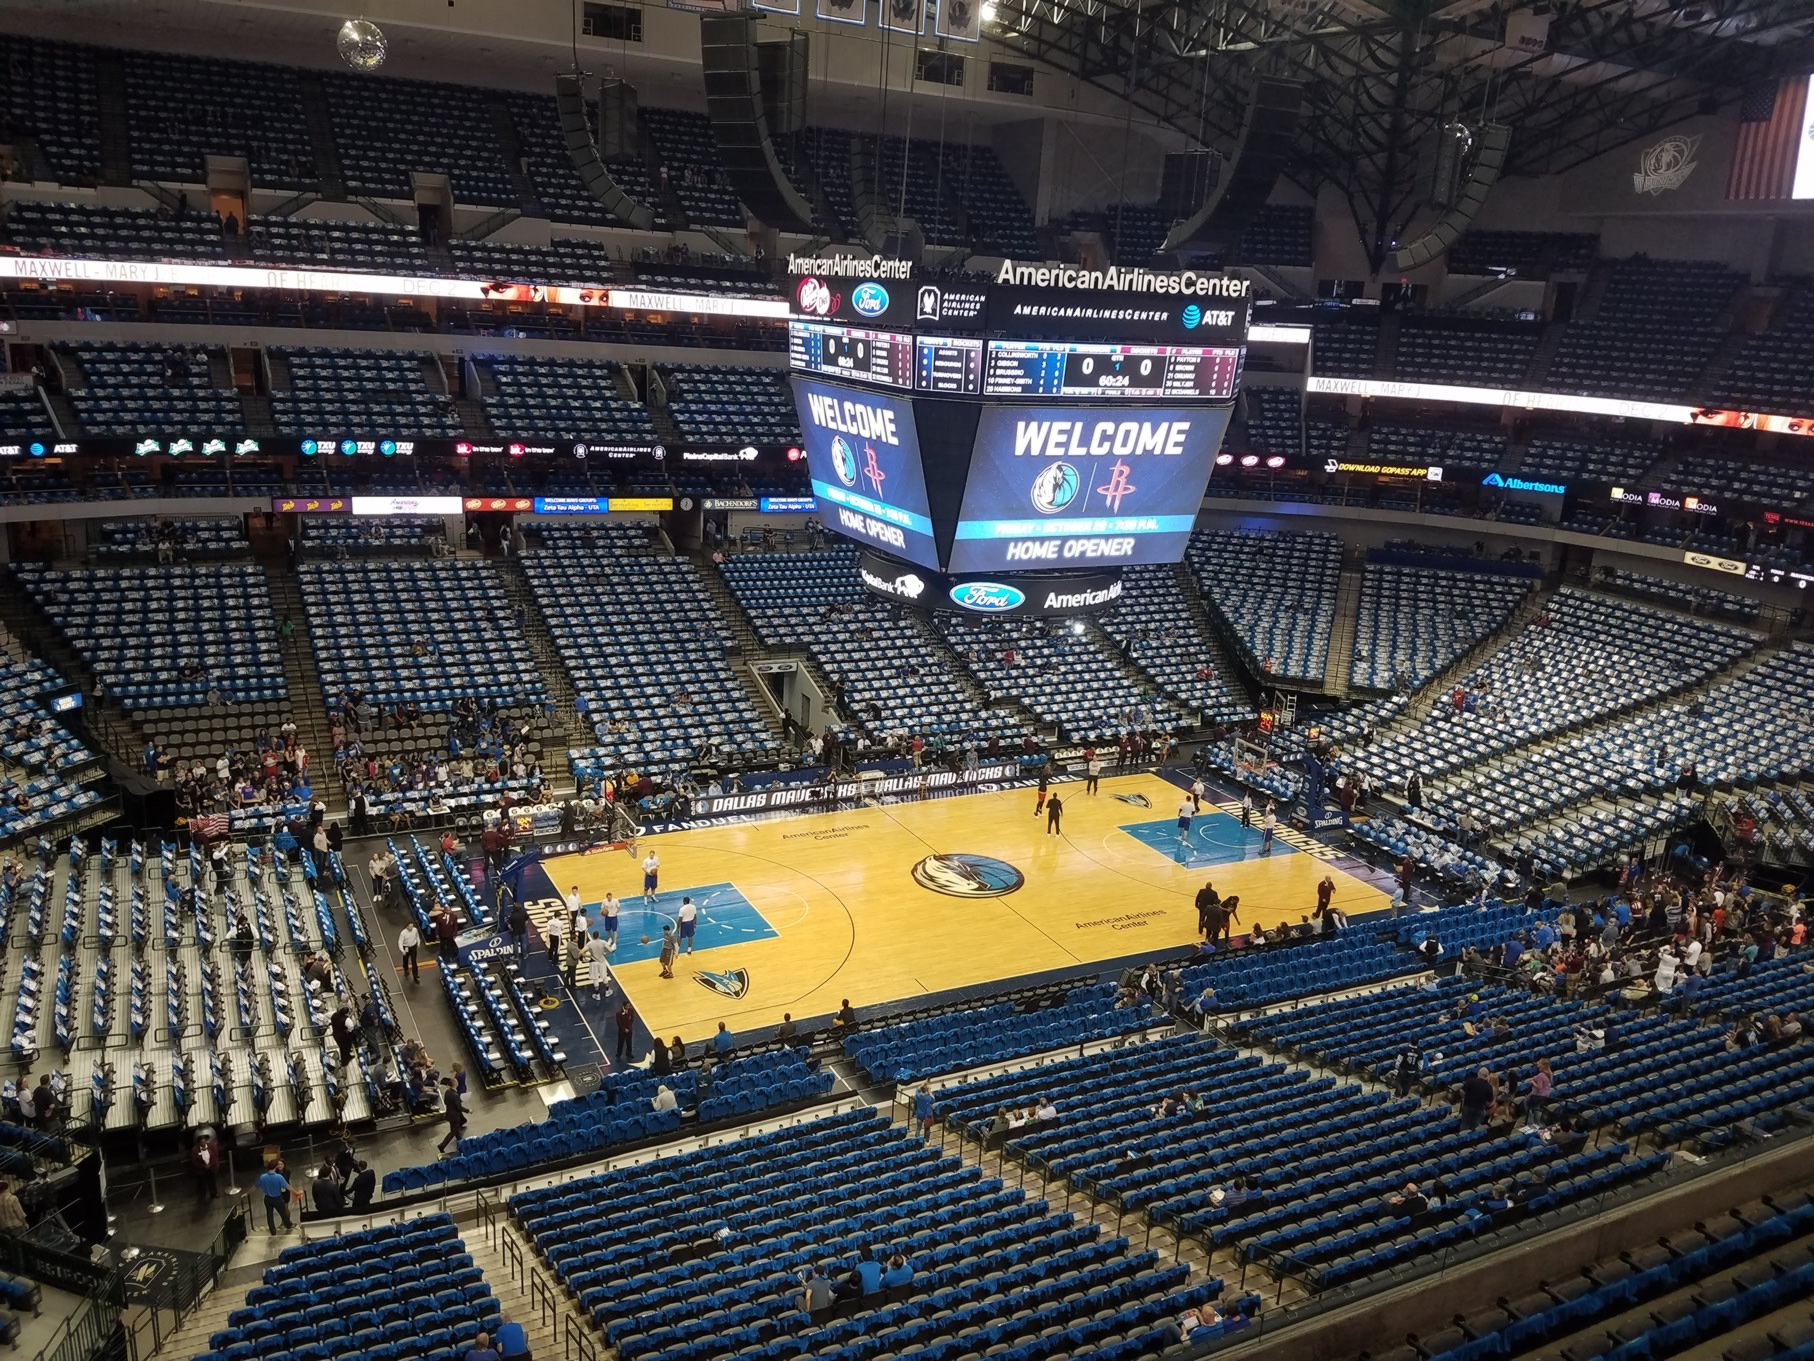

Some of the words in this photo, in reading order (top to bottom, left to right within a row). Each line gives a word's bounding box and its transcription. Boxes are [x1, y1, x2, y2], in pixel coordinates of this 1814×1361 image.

[14, 260, 91, 279] MAXWELL
[787, 252, 912, 279] AmericanAirlinesCenter
[997, 259, 1250, 298] AmericanAirlinesCenter
[629, 293, 684, 311] MAXWELL
[857, 287, 882, 311] Ford
[941, 300, 981, 310] AIRLINES
[942, 292, 986, 302] AMERICAN
[941, 308, 975, 318] CENTER
[1013, 303, 1168, 321] AMERICANAIRLINESCENTER
[1202, 310, 1236, 327] AT&T
[1082, 357, 1095, 375] 0
[1140, 359, 1153, 376] 0
[1114, 362, 1120, 371] 1
[1098, 375, 1130, 388] 60:24
[808, 393, 899, 446] WELCOME
[316, 441, 336, 450] TXU
[356, 441, 376, 450] TXU
[395, 441, 414, 450] TXU
[1014, 421, 1191, 457] WELCOME
[53, 444, 78, 454] AT&T
[1338, 462, 1381, 474] DOWNLOAD
[1381, 465, 1411, 476] GOPASS
[1411, 467, 1428, 477] APP
[1503, 477, 1566, 494] Albertsons
[543, 503, 557, 511] Zeta
[557, 503, 567, 511] Tau
[567, 503, 584, 512] Alpha
[587, 503, 600, 511] UTA
[839, 508, 866, 534] HOME
[866, 517, 907, 549] OPENER
[1006, 540, 1059, 561] HOME
[1063, 537, 1136, 558] OPENER
[963, 586, 1009, 609] Ford
[712, 793, 767, 813] DALLAS
[651, 815, 757, 834] FANDUEL
[1313, 816, 1343, 829] SPALDING
[535, 827, 559, 836] GEICO
[781, 824, 871, 841] AmericanAirlines
[813, 831, 849, 842] Center
[1074, 908, 1167, 931] AmericanAirlines
[1111, 919, 1149, 933] Center
